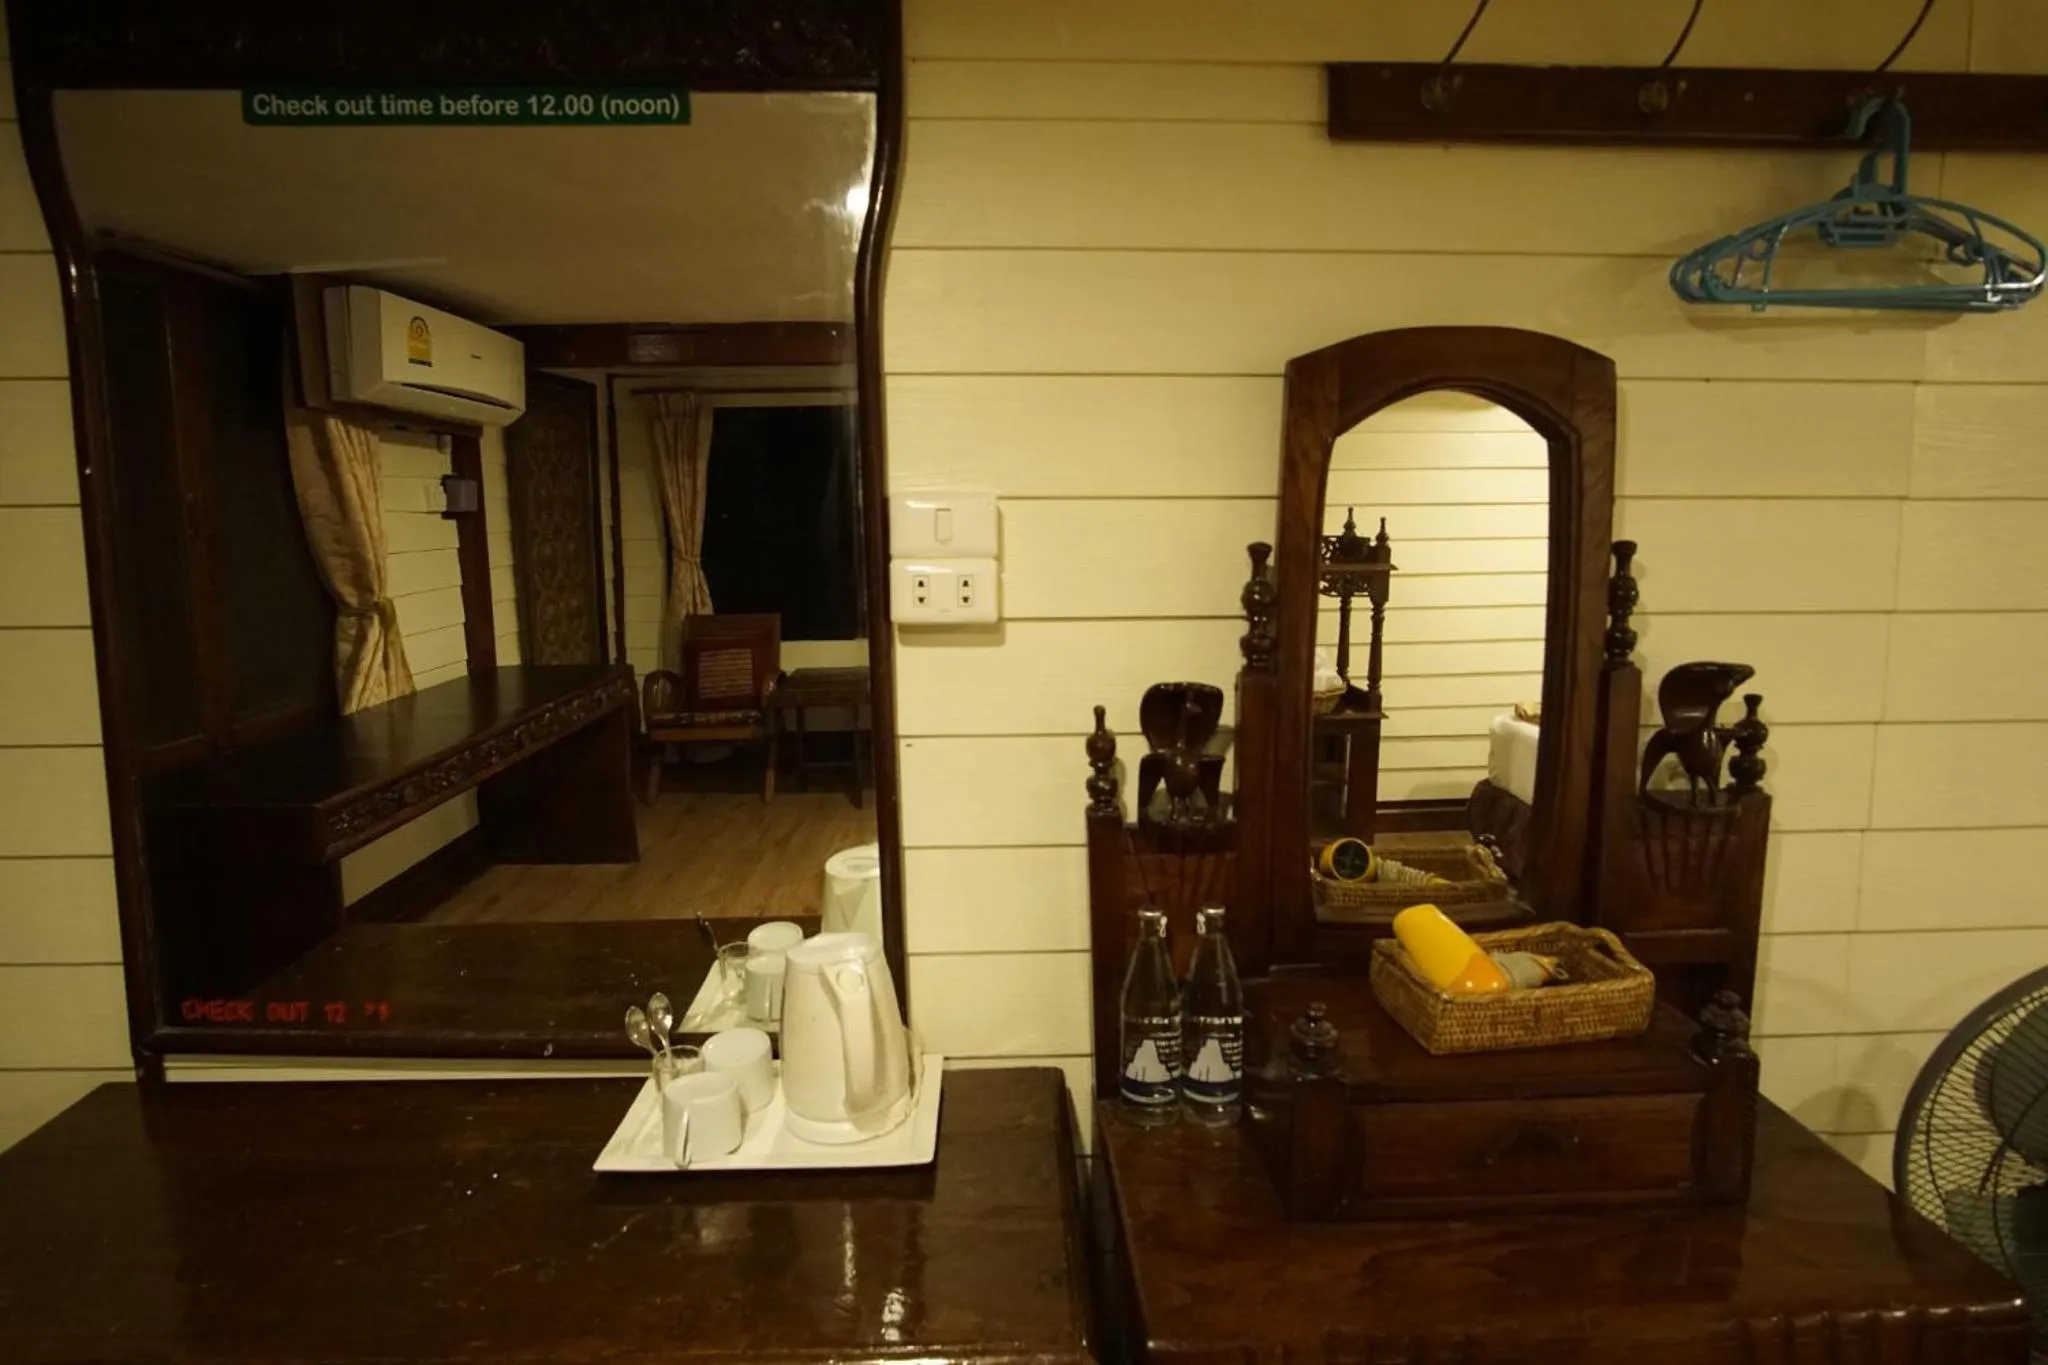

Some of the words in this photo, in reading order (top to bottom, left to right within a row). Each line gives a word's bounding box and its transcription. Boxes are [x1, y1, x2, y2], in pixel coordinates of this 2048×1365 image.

[252, 94, 329, 117] Check
[334, 95, 375, 117] out
[381, 94, 433, 117] time
[440, 94, 520, 116] before
[526, 94, 595, 116] 12.00
[601, 93, 681, 118] (noon)
[182, 999, 254, 1022] CHECK
[266, 1002, 309, 1023] OUT
[324, 1002, 347, 1023] 12
